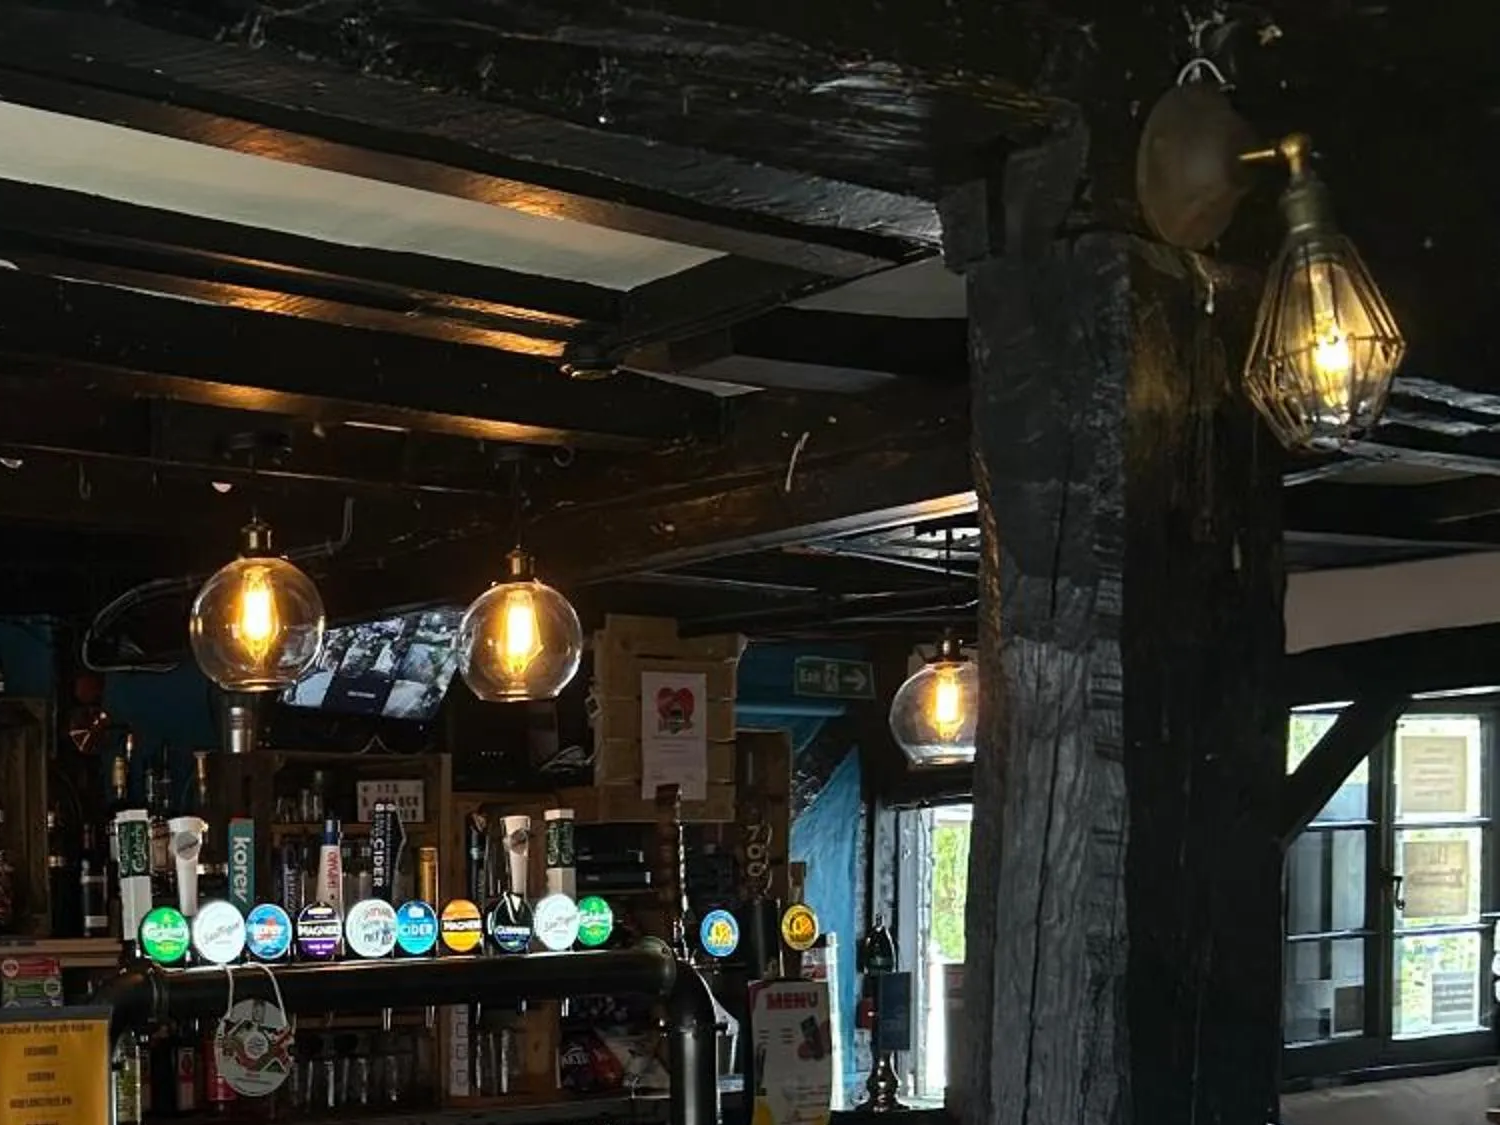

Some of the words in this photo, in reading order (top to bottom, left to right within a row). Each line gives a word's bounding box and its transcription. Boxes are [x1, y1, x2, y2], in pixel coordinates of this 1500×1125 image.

[233, 836, 250, 903] korev
[373, 838, 385, 887] CIDER
[766, 991, 819, 1011] MENU
